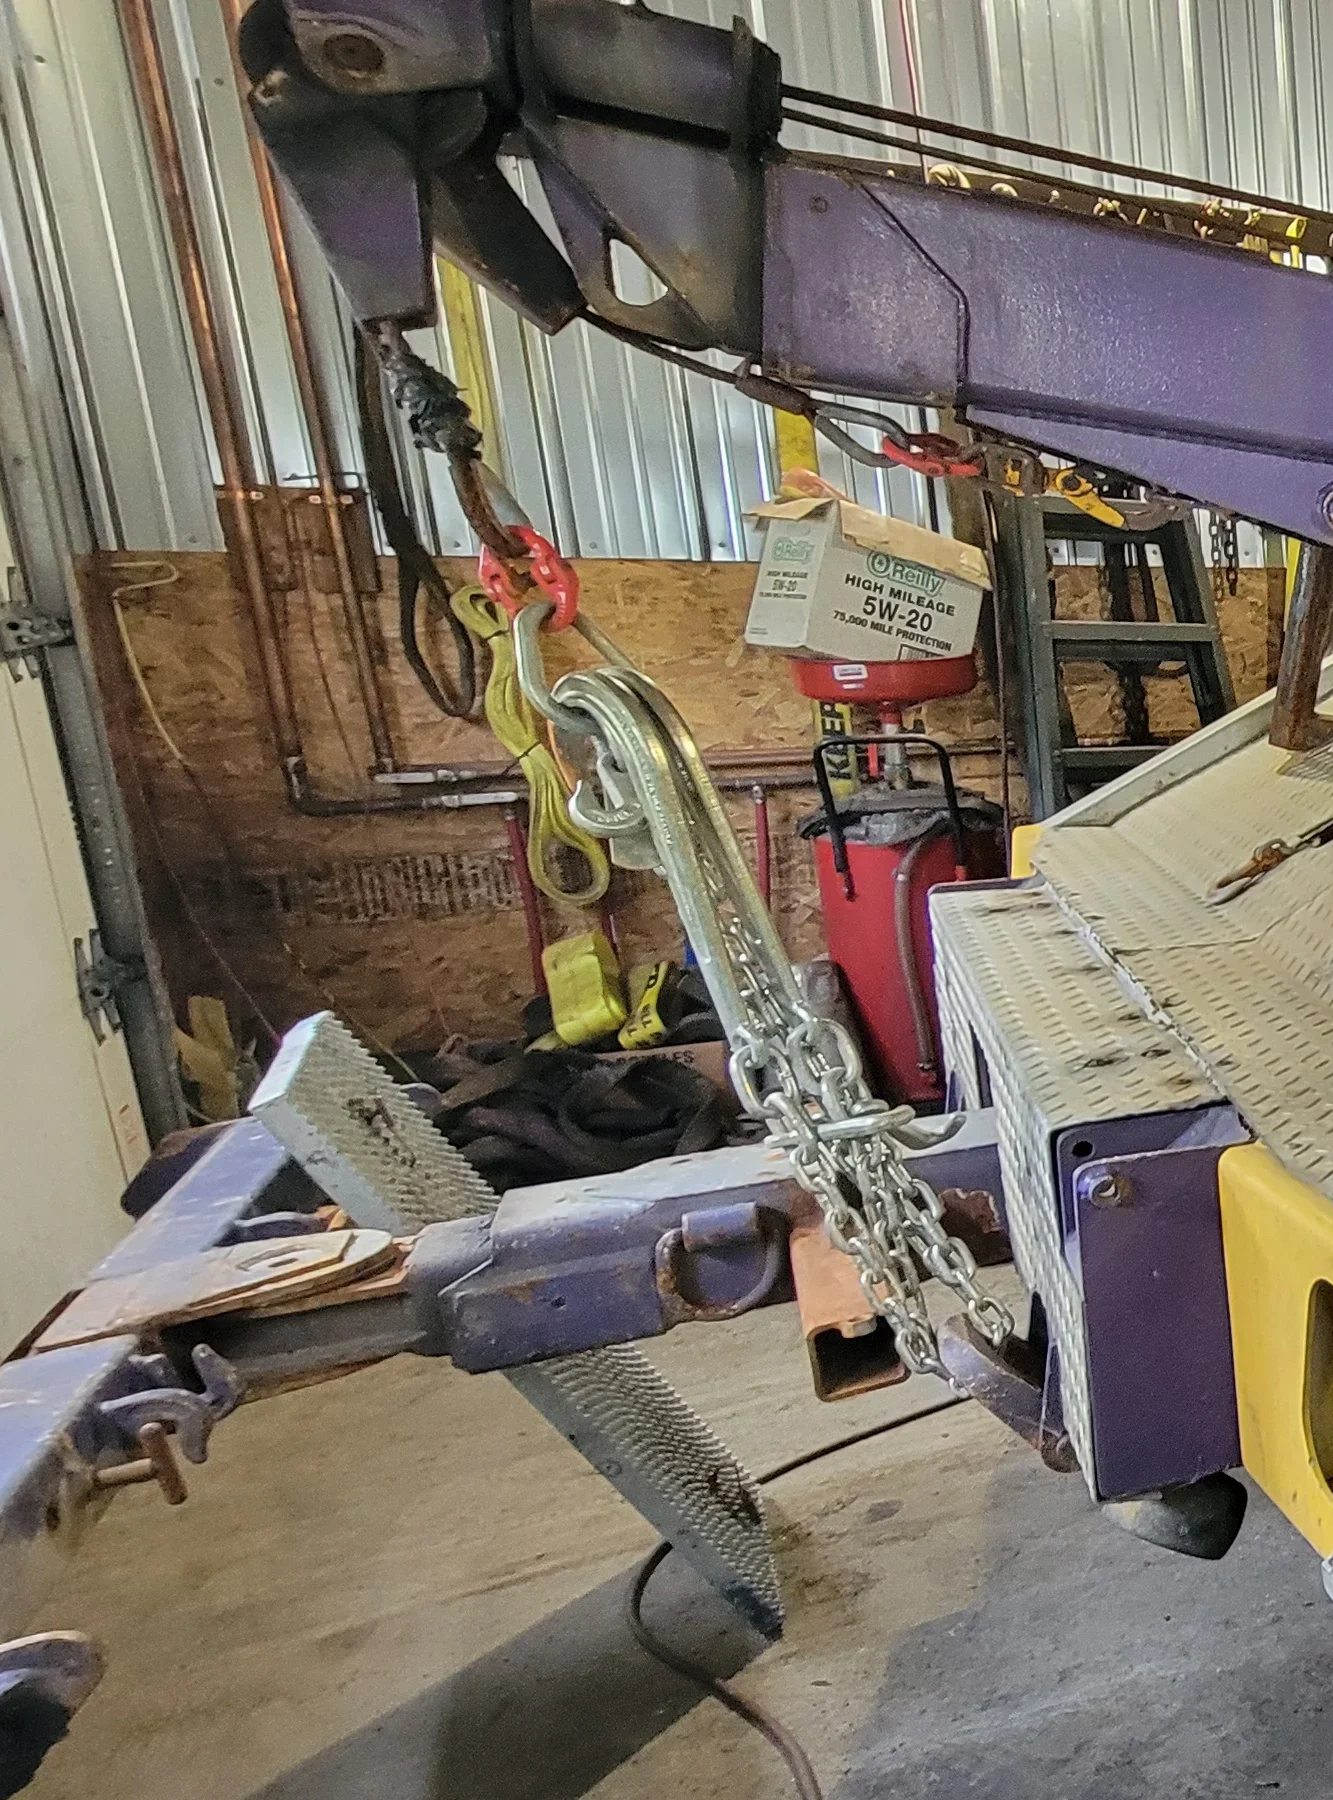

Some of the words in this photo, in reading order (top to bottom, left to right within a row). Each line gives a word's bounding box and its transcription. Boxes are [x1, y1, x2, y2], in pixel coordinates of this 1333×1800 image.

[844, 573, 884, 595] HIGH
[889, 584, 956, 617] MILEAGE
[862, 596, 933, 632] 5W-20
[833, 610, 868, 628] 75,000
[870, 618, 894, 637] MILE
[895, 628, 952, 652] PROTECTION
